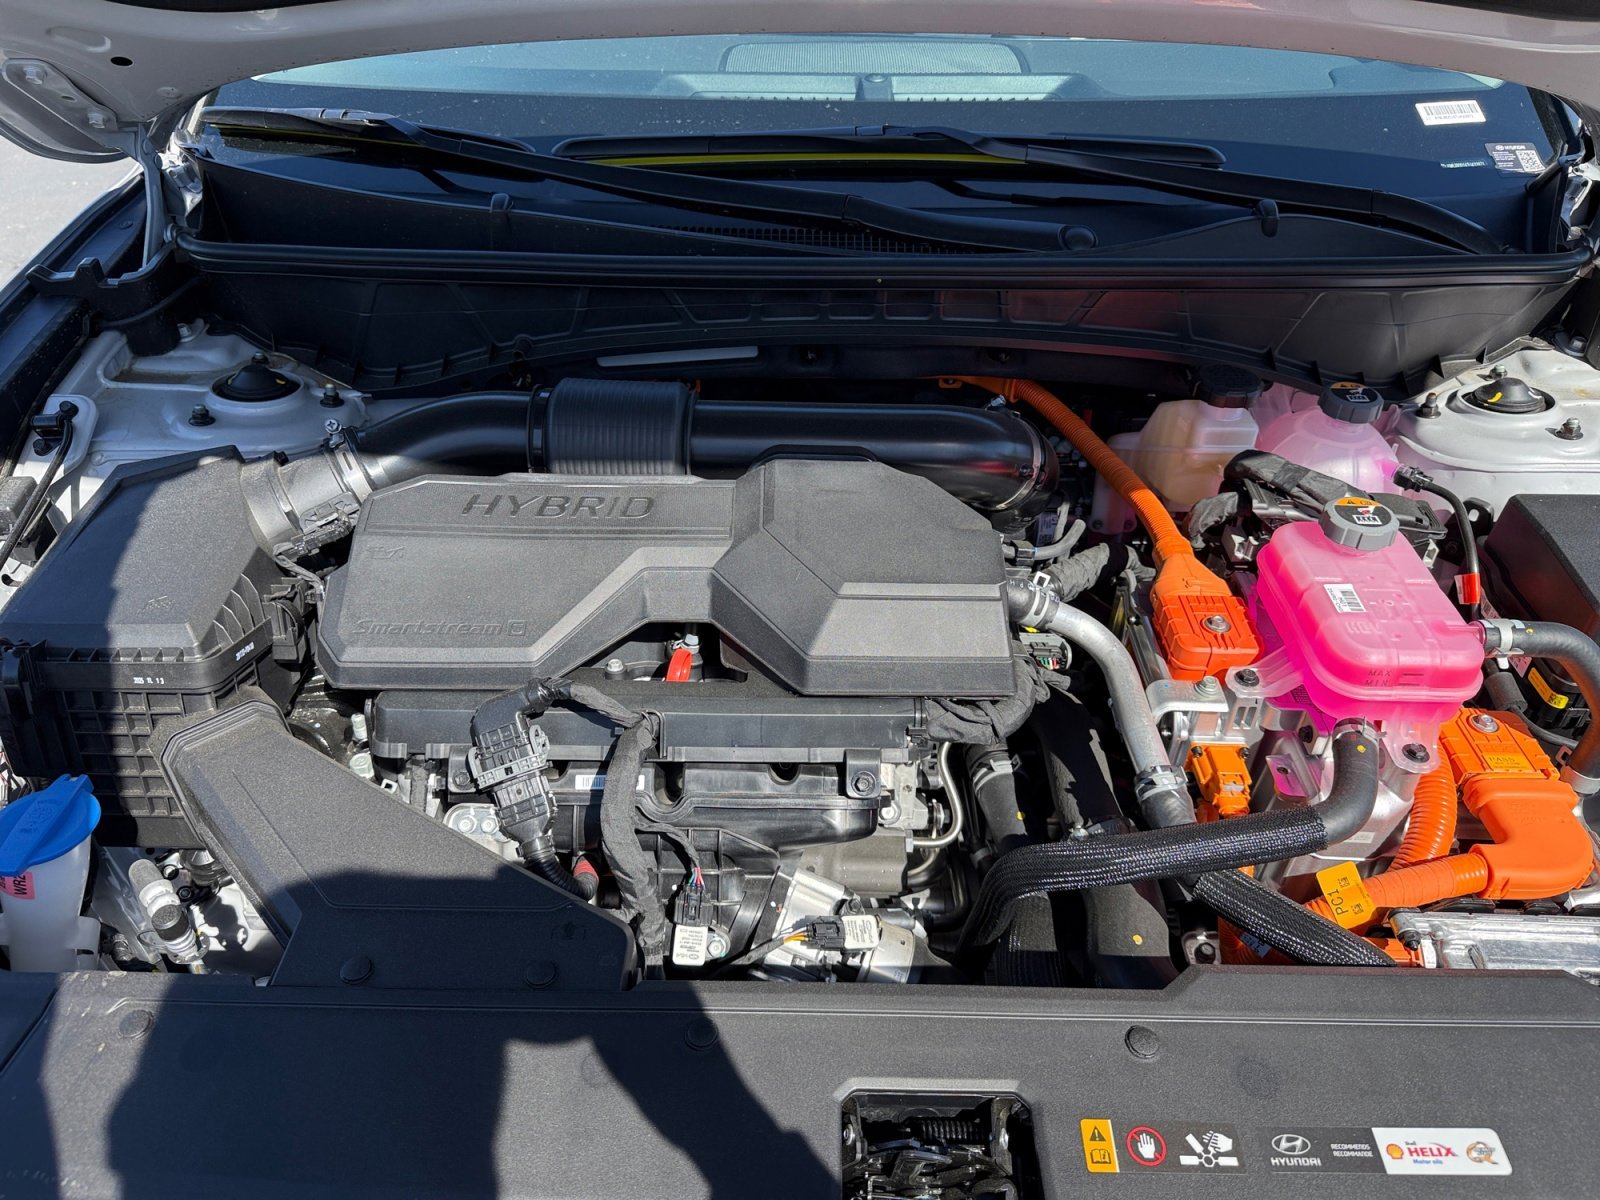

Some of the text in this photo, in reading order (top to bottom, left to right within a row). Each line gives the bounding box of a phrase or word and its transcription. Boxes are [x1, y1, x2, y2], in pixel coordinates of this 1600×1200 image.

[461, 494, 655, 518] HYBRID
[352, 618, 502, 635] Smartstream
[1365, 679, 1389, 687] MIN
[1327, 889, 1349, 916] PC1
[1407, 1146, 1457, 1157] HELIX
[1270, 1157, 1322, 1166] HYUNDAI
